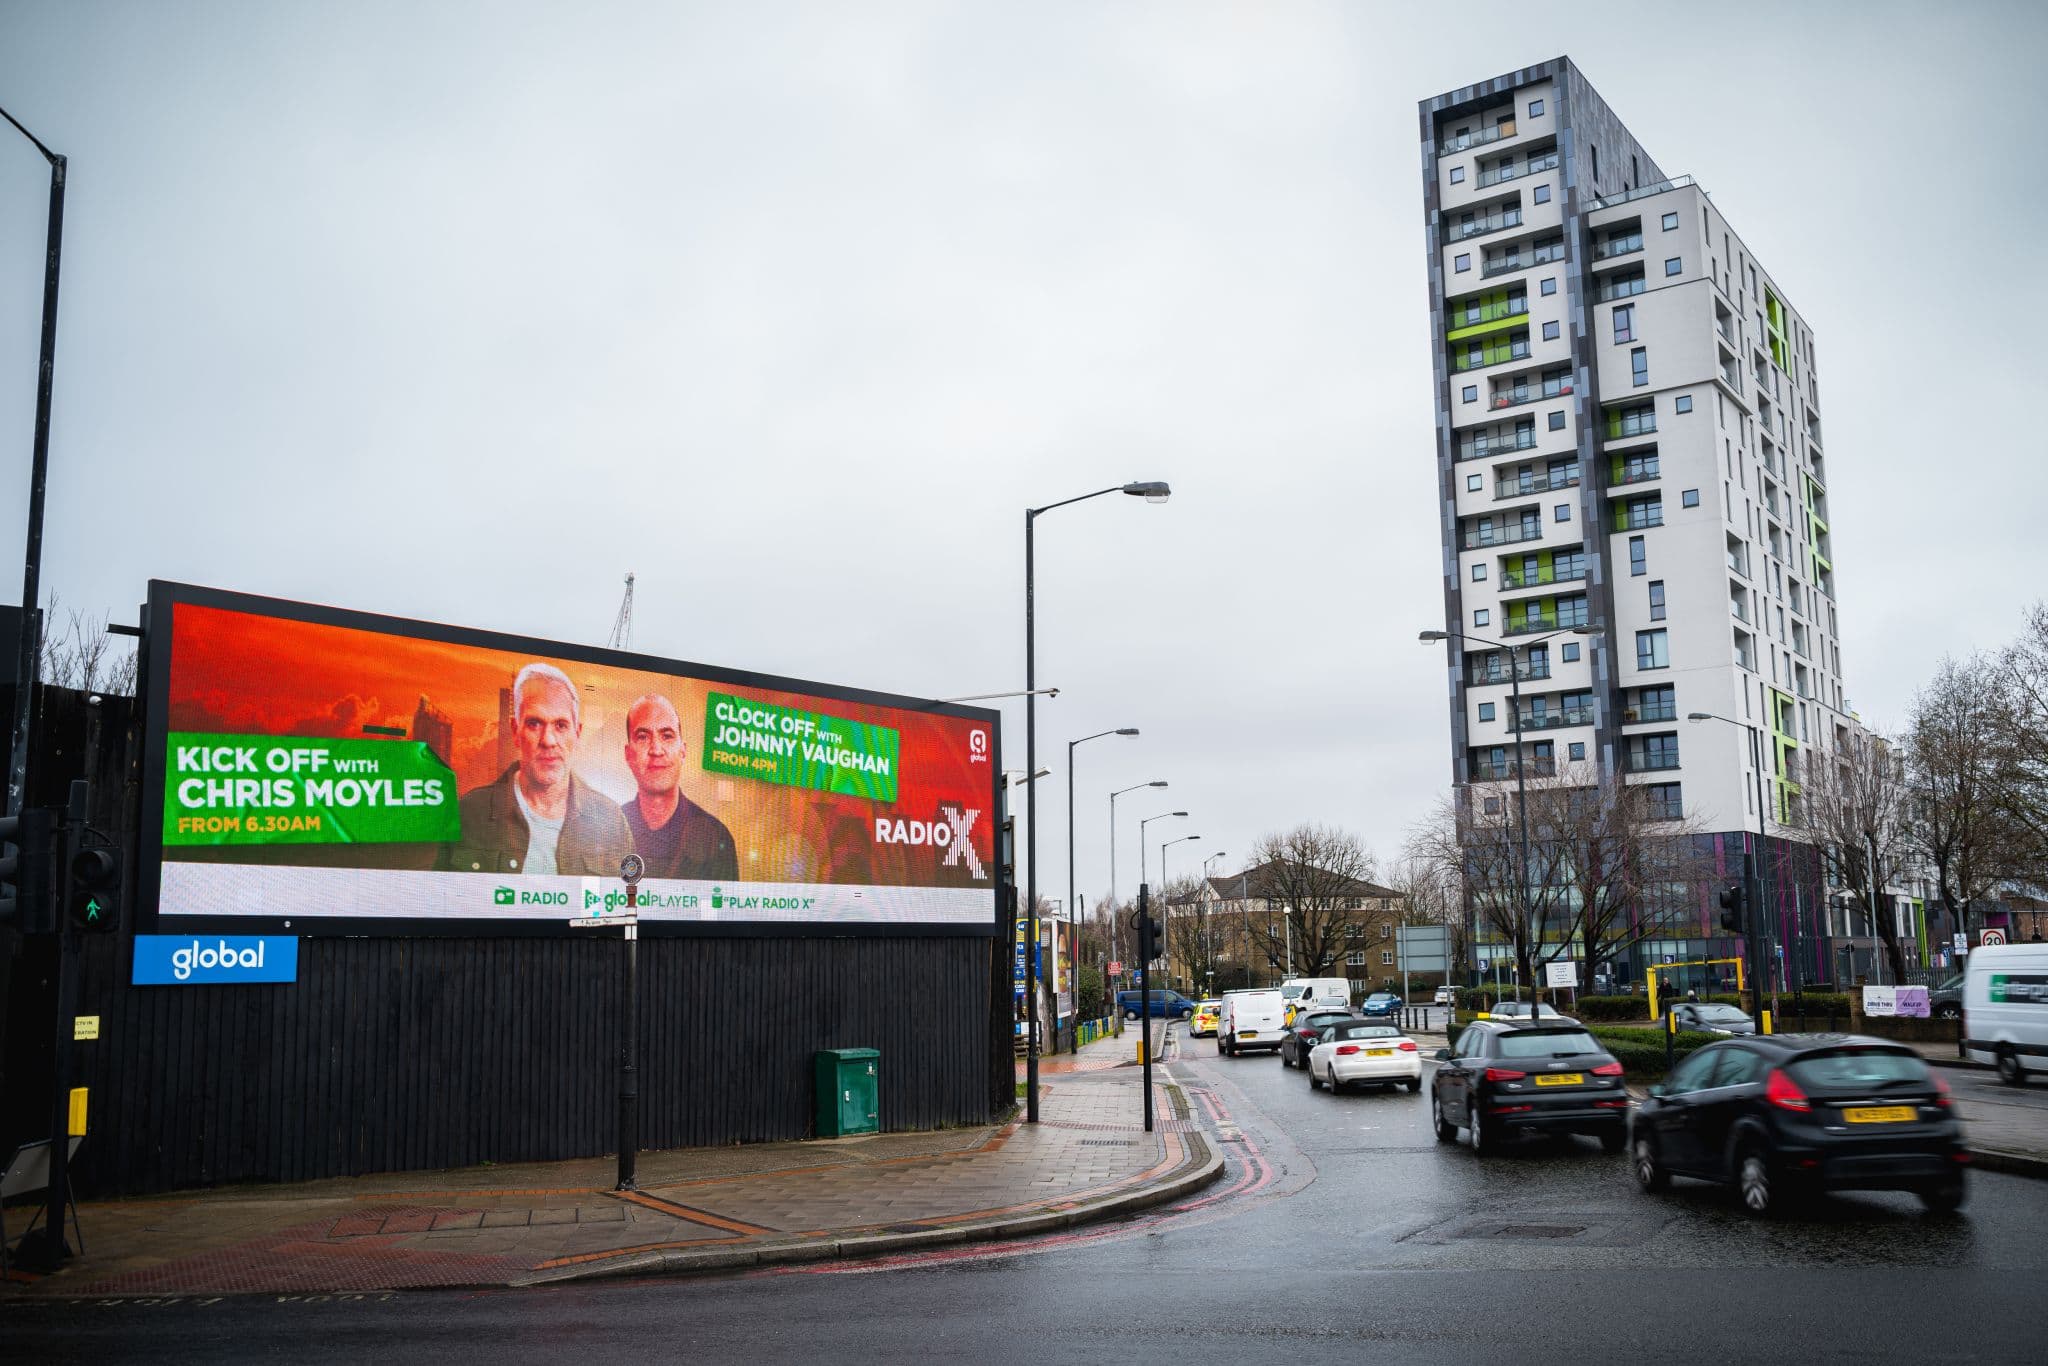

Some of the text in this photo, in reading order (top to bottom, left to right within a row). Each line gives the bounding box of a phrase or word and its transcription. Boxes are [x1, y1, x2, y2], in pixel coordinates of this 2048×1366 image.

[715, 702, 842, 745] CLOCK OFF WITH
[177, 746, 379, 773] KICK OFF WITH
[712, 750, 777, 773] FROM 4PM
[713, 724, 890, 776] JOHNNY VAUGHAN
[970, 752, 987, 763] global
[178, 778, 444, 808] CHRIS MOYLES
[178, 815, 321, 833] FROM 6.30AM
[521, 891, 569, 905] RADIO
[762, 897, 799, 909] RADIO
[1986, 937, 2002, 946] 20
[172, 939, 265, 980] global
